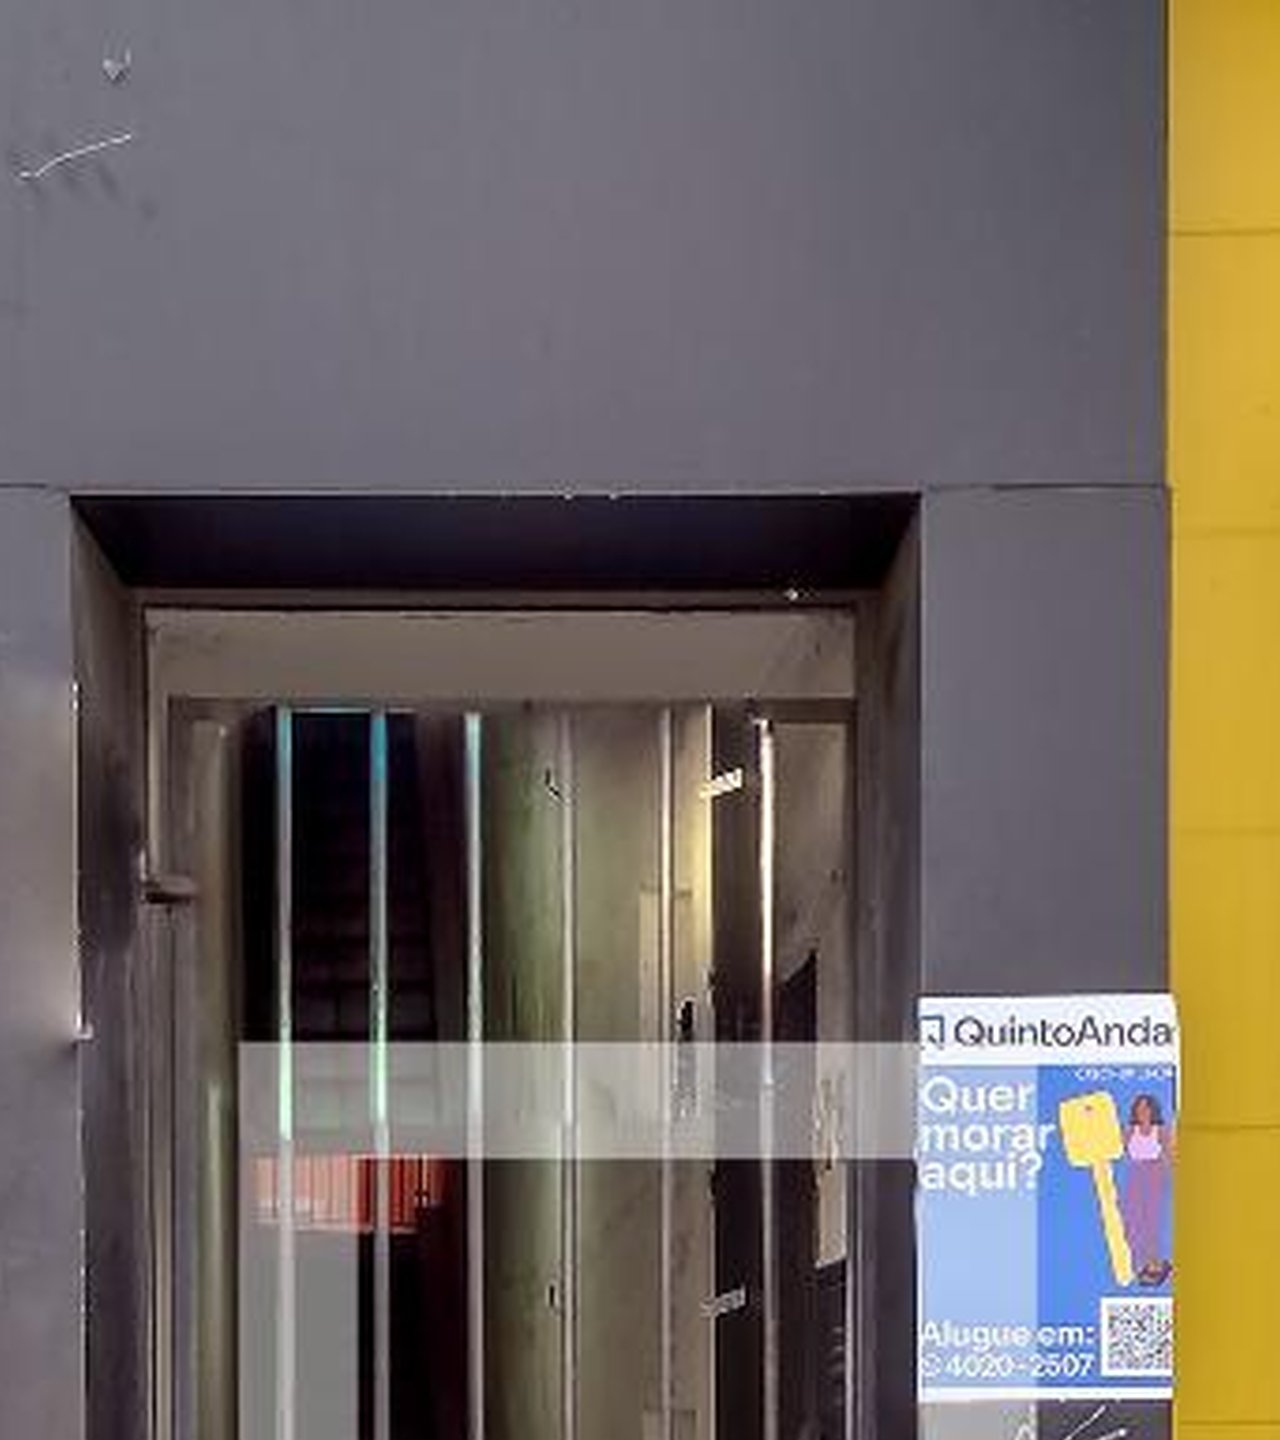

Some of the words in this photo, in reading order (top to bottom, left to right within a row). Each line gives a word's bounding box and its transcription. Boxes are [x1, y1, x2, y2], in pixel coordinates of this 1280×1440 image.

[953, 1014, 1176, 1047] QuintoAnda
[922, 1075, 1035, 1116] Quer
[920, 1122, 1056, 1152] morar
[920, 1152, 1043, 1196] aqui?
[923, 1320, 1032, 1352] Alugue
[1037, 1325, 1096, 1346] em:
